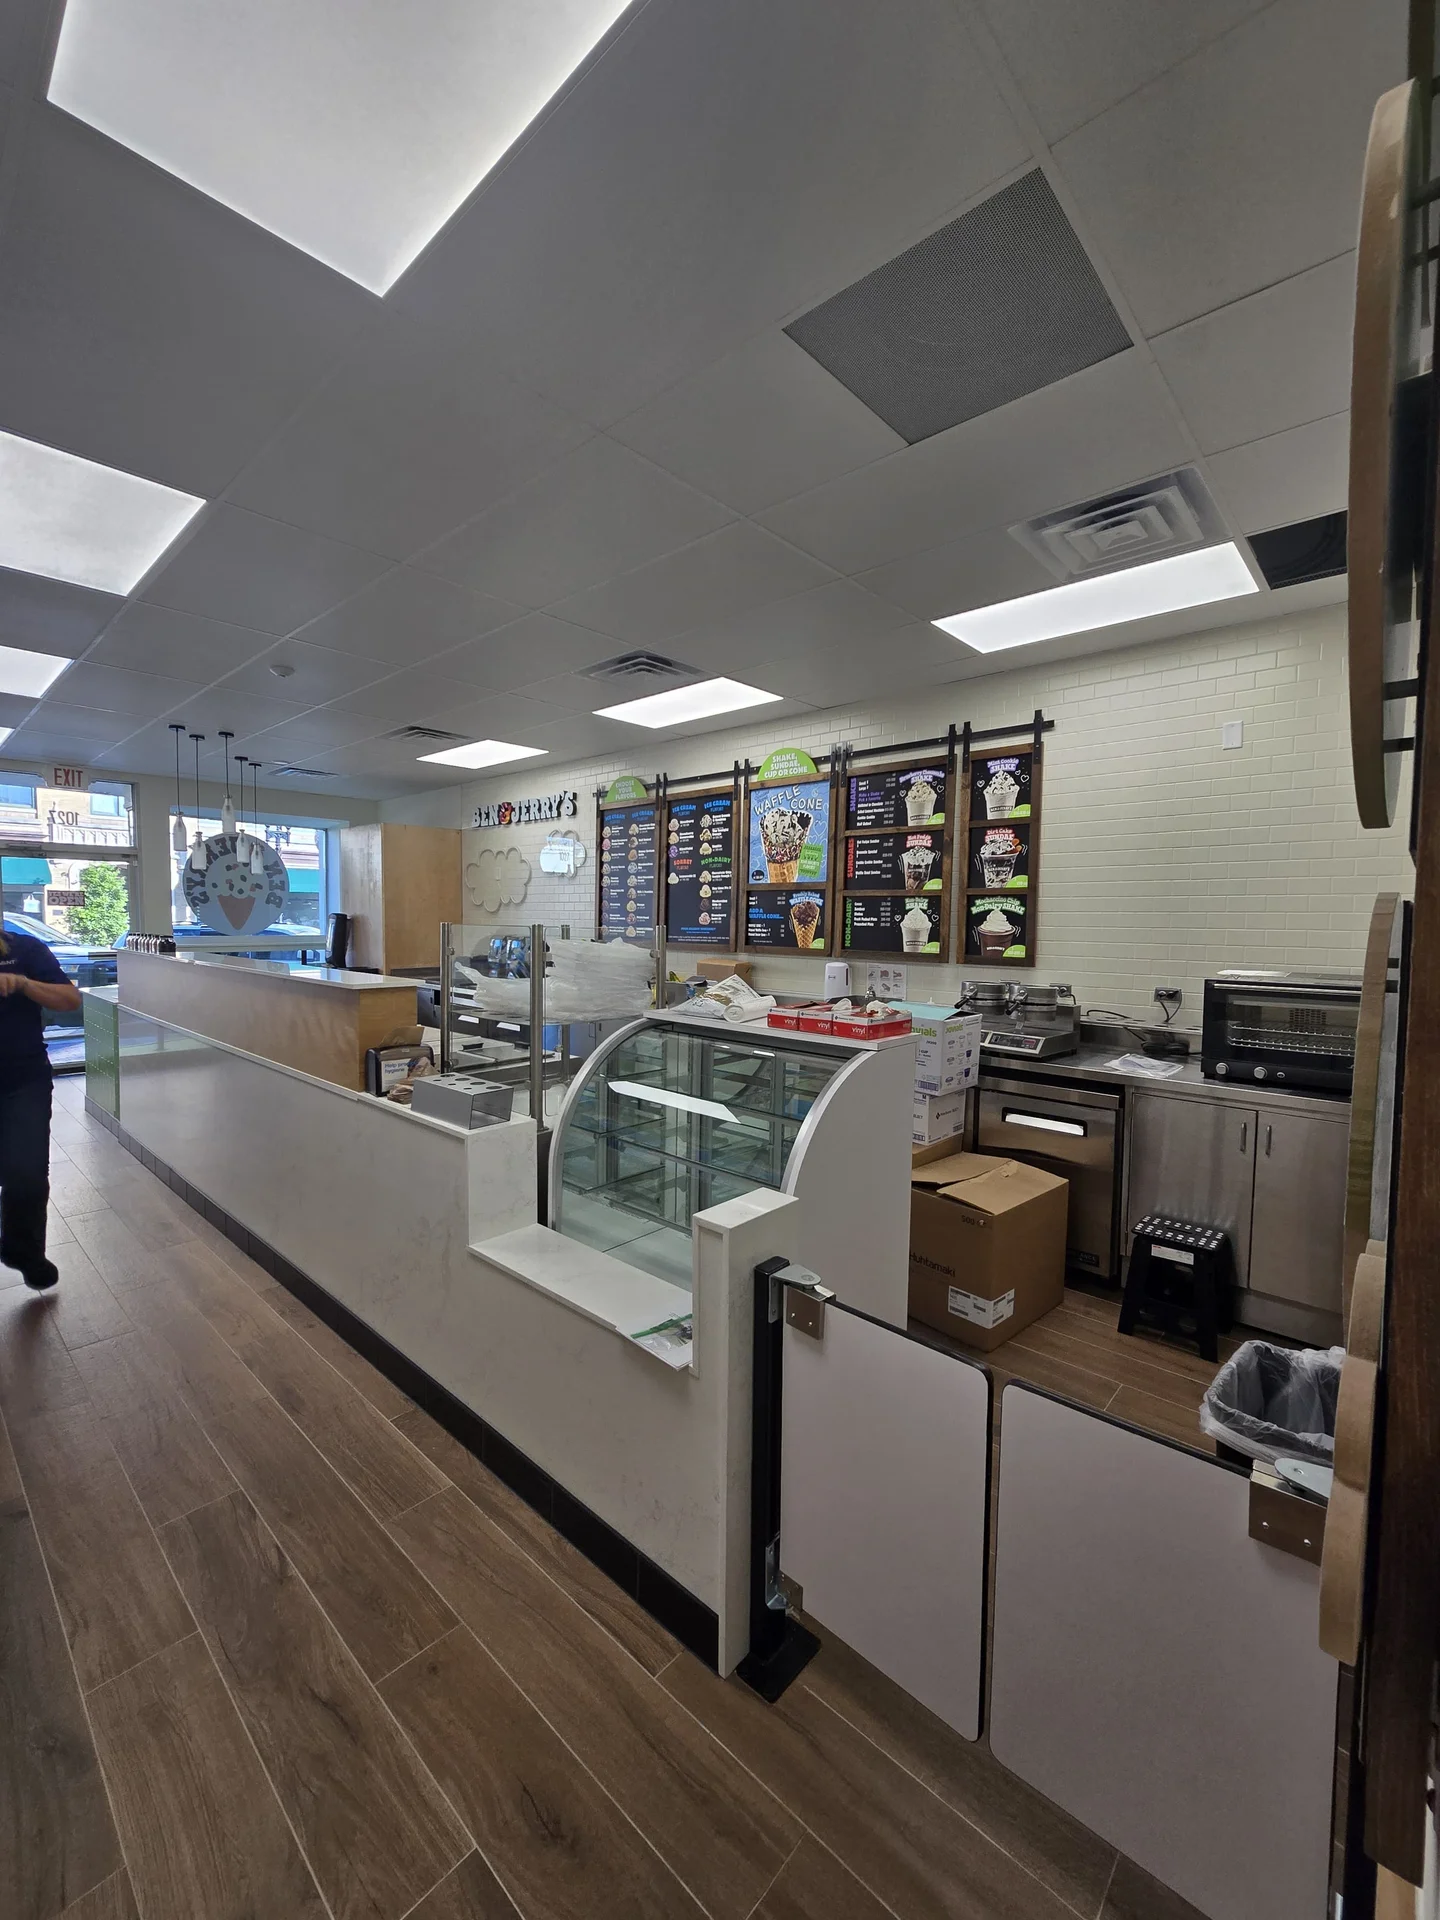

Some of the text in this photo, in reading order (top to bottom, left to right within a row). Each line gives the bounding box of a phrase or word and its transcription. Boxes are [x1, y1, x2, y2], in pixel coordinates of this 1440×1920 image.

[772, 753, 798, 762] SHAKE,
[771, 760, 800, 770] SUNDAE,
[764, 770, 777, 778] CUP
[789, 766, 808, 774] CONE
[54, 768, 83, 788] EXIT
[754, 785, 801, 816] WAFFLE
[790, 798, 823, 811] CONE
[472, 791, 577, 828] BEN JERRY'S
[701, 857, 731, 866] NON-DAIRY
[49, 896, 84, 905] OPEN
[1003, 903, 1026, 915] SHAKE
[784, 1018, 796, 1026] vinyl
[817, 1021, 830, 1030] vinyl
[852, 1026, 865, 1035] vinyl
